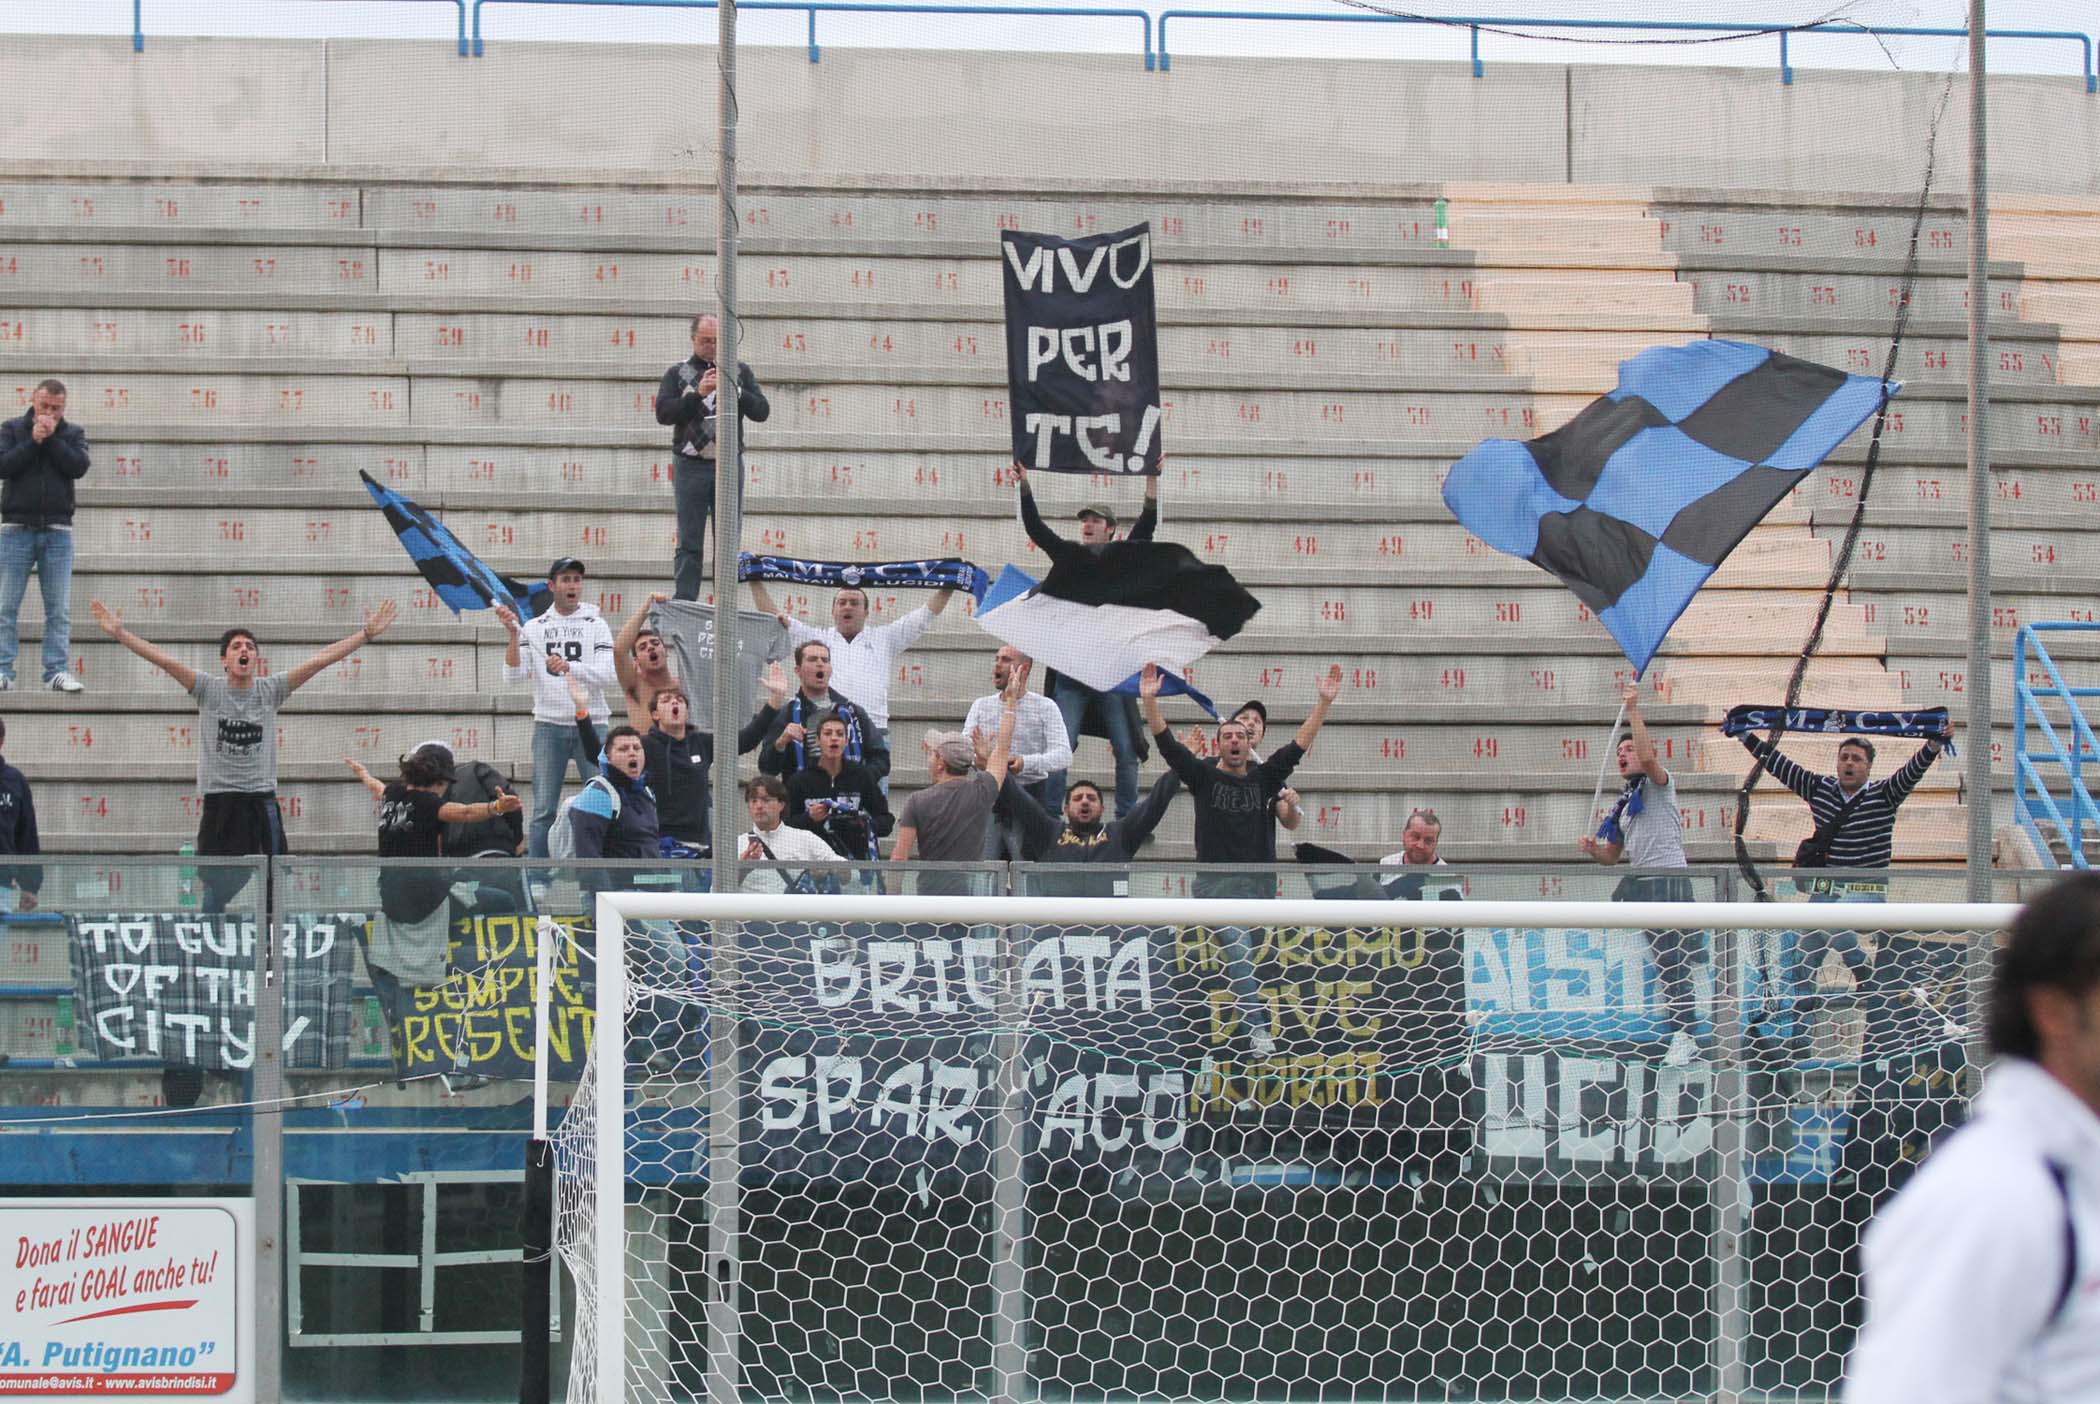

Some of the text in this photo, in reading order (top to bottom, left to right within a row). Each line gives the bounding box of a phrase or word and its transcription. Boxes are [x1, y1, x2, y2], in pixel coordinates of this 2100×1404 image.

[1003, 232, 1150, 293] VIVO
[1727, 284, 1750, 303] 52
[1028, 319, 1132, 382] PER
[1925, 351, 1947, 368] 54
[1025, 404, 1160, 473] TE!
[1998, 481, 2022, 499] 54
[1294, 536, 1319, 555] 48
[1379, 536, 1404, 556] 49
[1863, 542, 1885, 561] 52
[2033, 546, 2056, 564] 54
[1322, 602, 1346, 621] 48
[1410, 601, 1434, 620] 49
[1496, 602, 1521, 622] 50
[1904, 606, 1929, 627] 52
[1259, 667, 1284, 687] 47
[1353, 668, 1377, 689] 48
[1441, 668, 1466, 688] 49
[1939, 671, 1964, 693] 52
[1381, 738, 1406, 759] 48
[1473, 738, 1499, 758] 49
[1562, 739, 1588, 760] 50
[1317, 806, 1341, 826] 47
[1501, 807, 1527, 827] 49
[79, 922, 150, 954] TO
[104, 963, 285, 1006] OF TH
[414, 967, 583, 1011] SEMPE
[761, 1055, 1188, 1152] SPARACO
[16, 1216, 159, 1269] Dona il SANGUE
[15, 1250, 218, 1313] e farai GOAL anche tu!
[0, 1377, 94, 1390] omunale@avis.it
[105, 1376, 217, 1390] www.avisbrindisi.it
